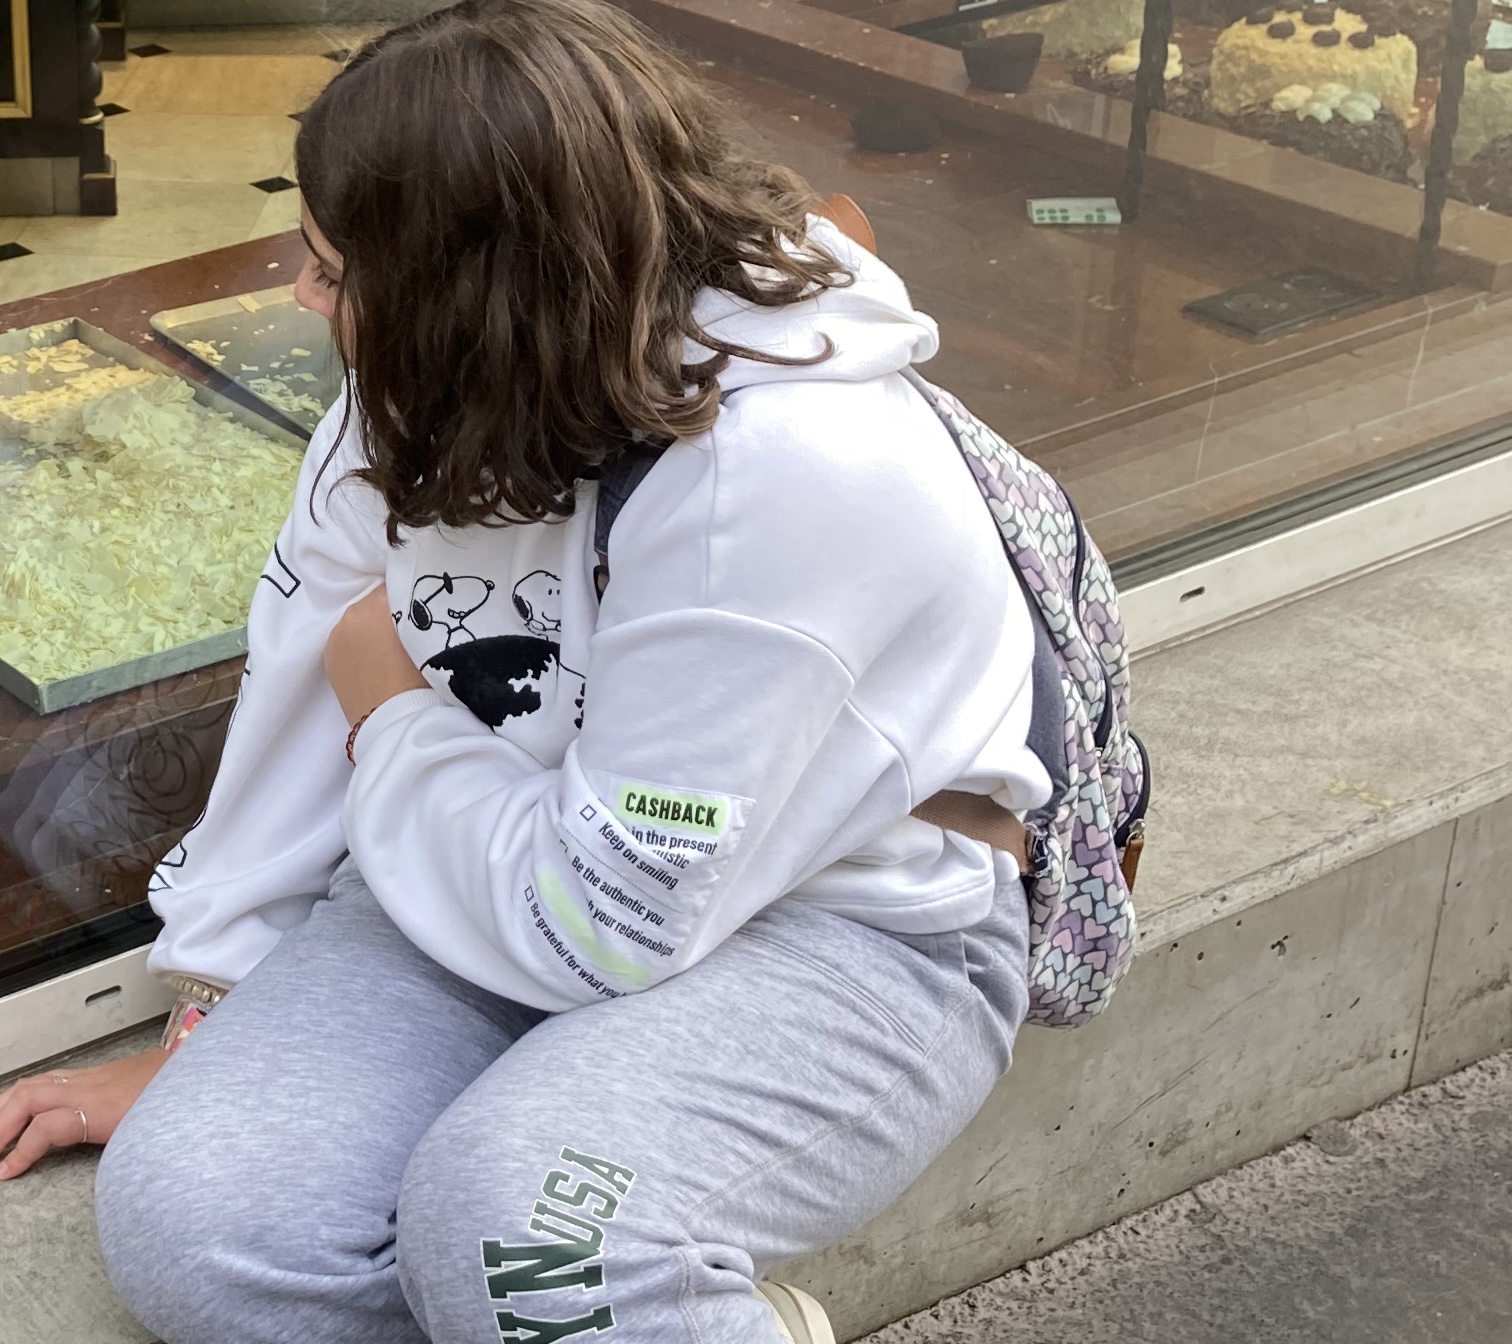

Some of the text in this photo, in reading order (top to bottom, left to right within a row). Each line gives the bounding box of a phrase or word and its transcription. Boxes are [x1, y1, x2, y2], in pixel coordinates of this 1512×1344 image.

[625, 792, 718, 828] CASHBACK
[631, 826, 718, 856] in the present
[571, 855, 584, 873] Be
[582, 866, 601, 887] the
[599, 881, 646, 916] authentic
[641, 908, 665, 927] you
[598, 821, 680, 891] Keep on smiling
[530, 902, 620, 999] Be grateful for what you
[592, 907, 676, 957] your relationships
[528, 1144, 637, 1250] USA
